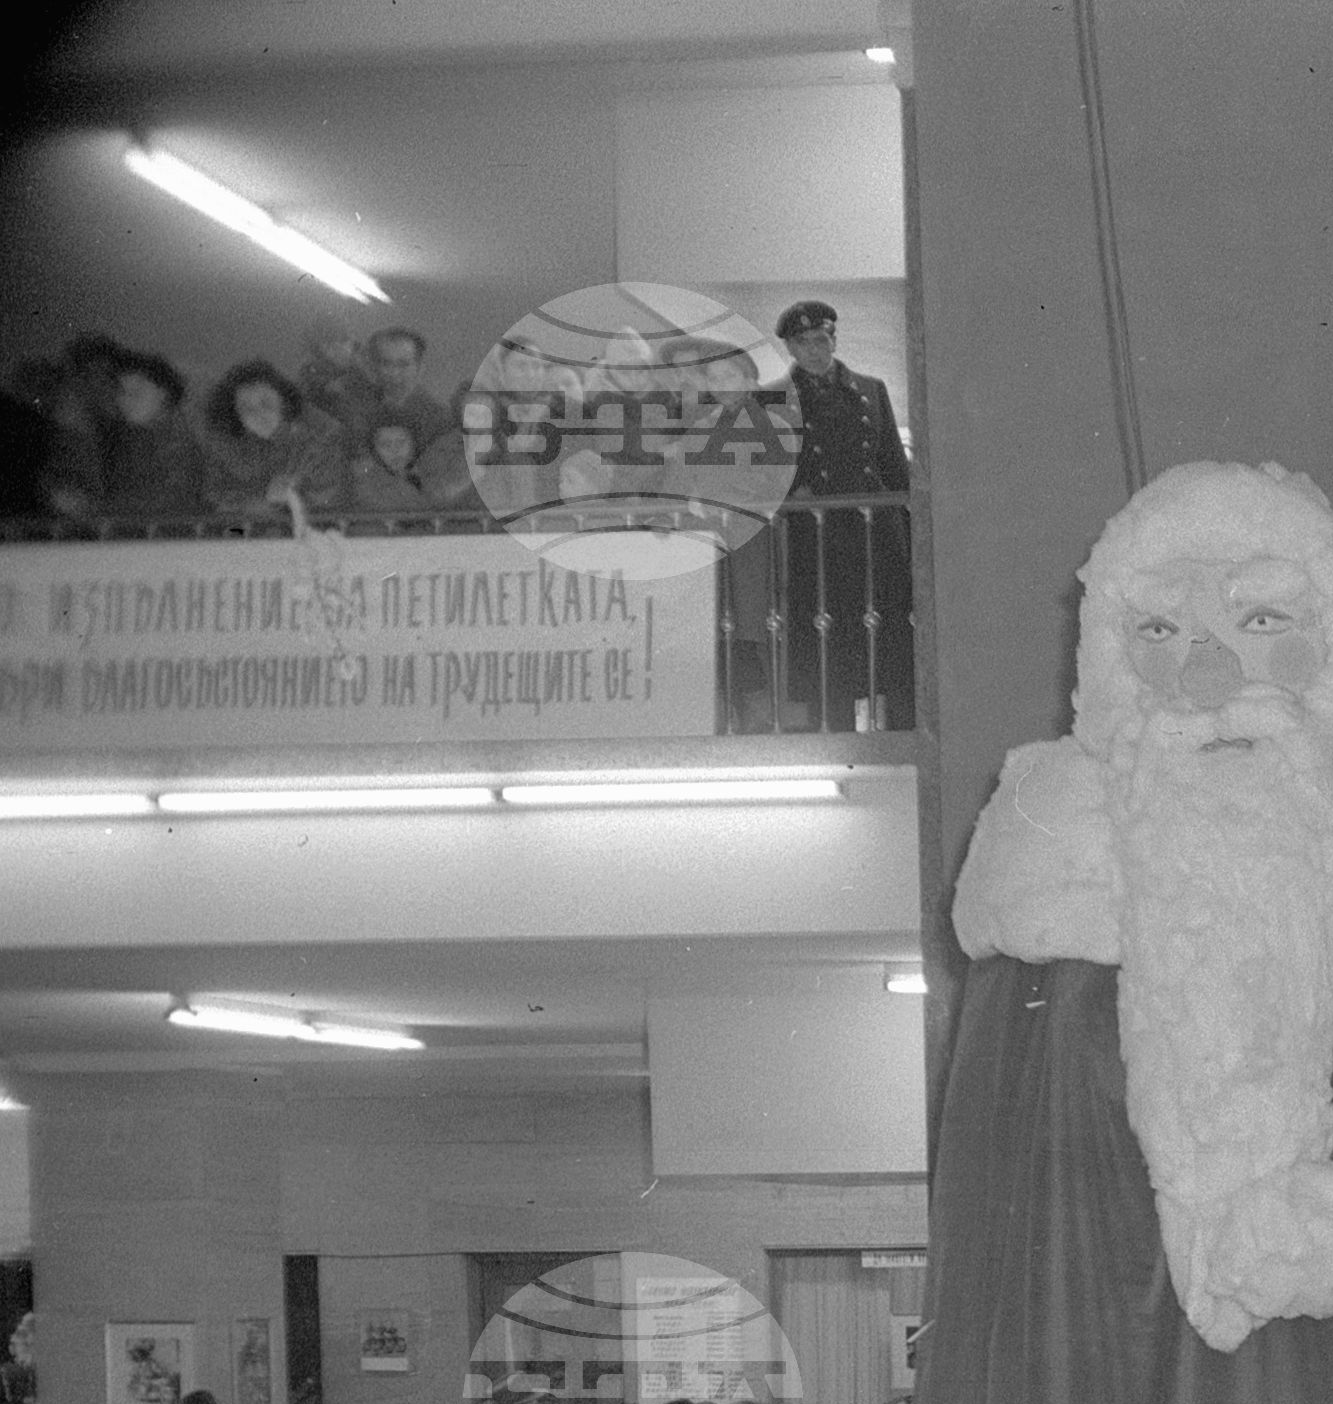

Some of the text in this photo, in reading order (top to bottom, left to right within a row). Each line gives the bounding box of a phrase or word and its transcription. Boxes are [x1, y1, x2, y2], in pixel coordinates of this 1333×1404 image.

[380, 557, 637, 628] ПЕТИЛЕТКАТА,
[381, 653, 416, 706] НА
[426, 648, 593, 720] ТРУДЕЩИТЕ
